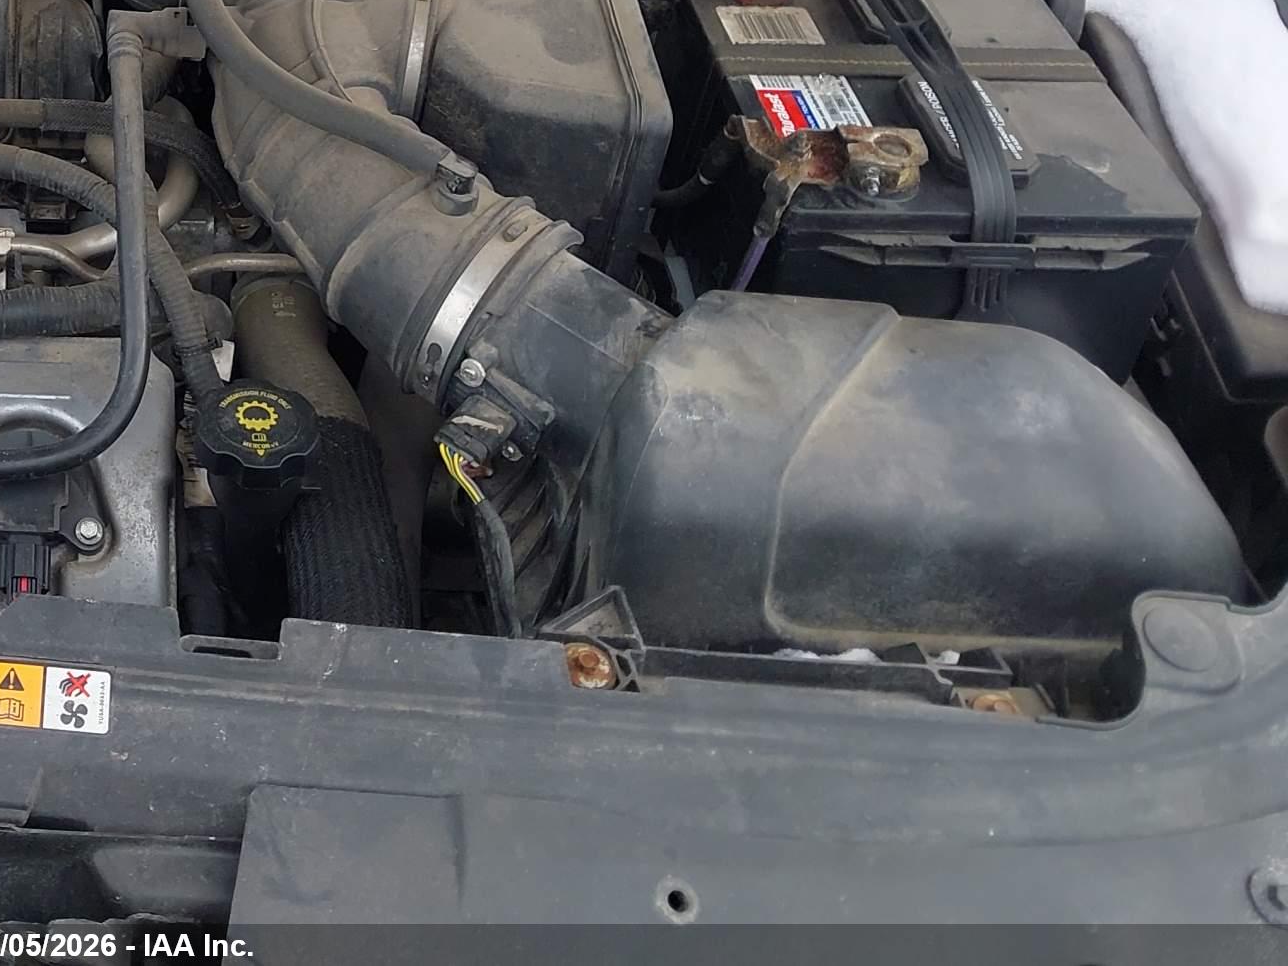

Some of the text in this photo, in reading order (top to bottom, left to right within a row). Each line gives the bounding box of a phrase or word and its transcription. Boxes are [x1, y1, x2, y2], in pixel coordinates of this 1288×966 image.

[917, 81, 943, 110] POISON
[218, 390, 293, 410] TRANSMISSION FLUID ONLY
